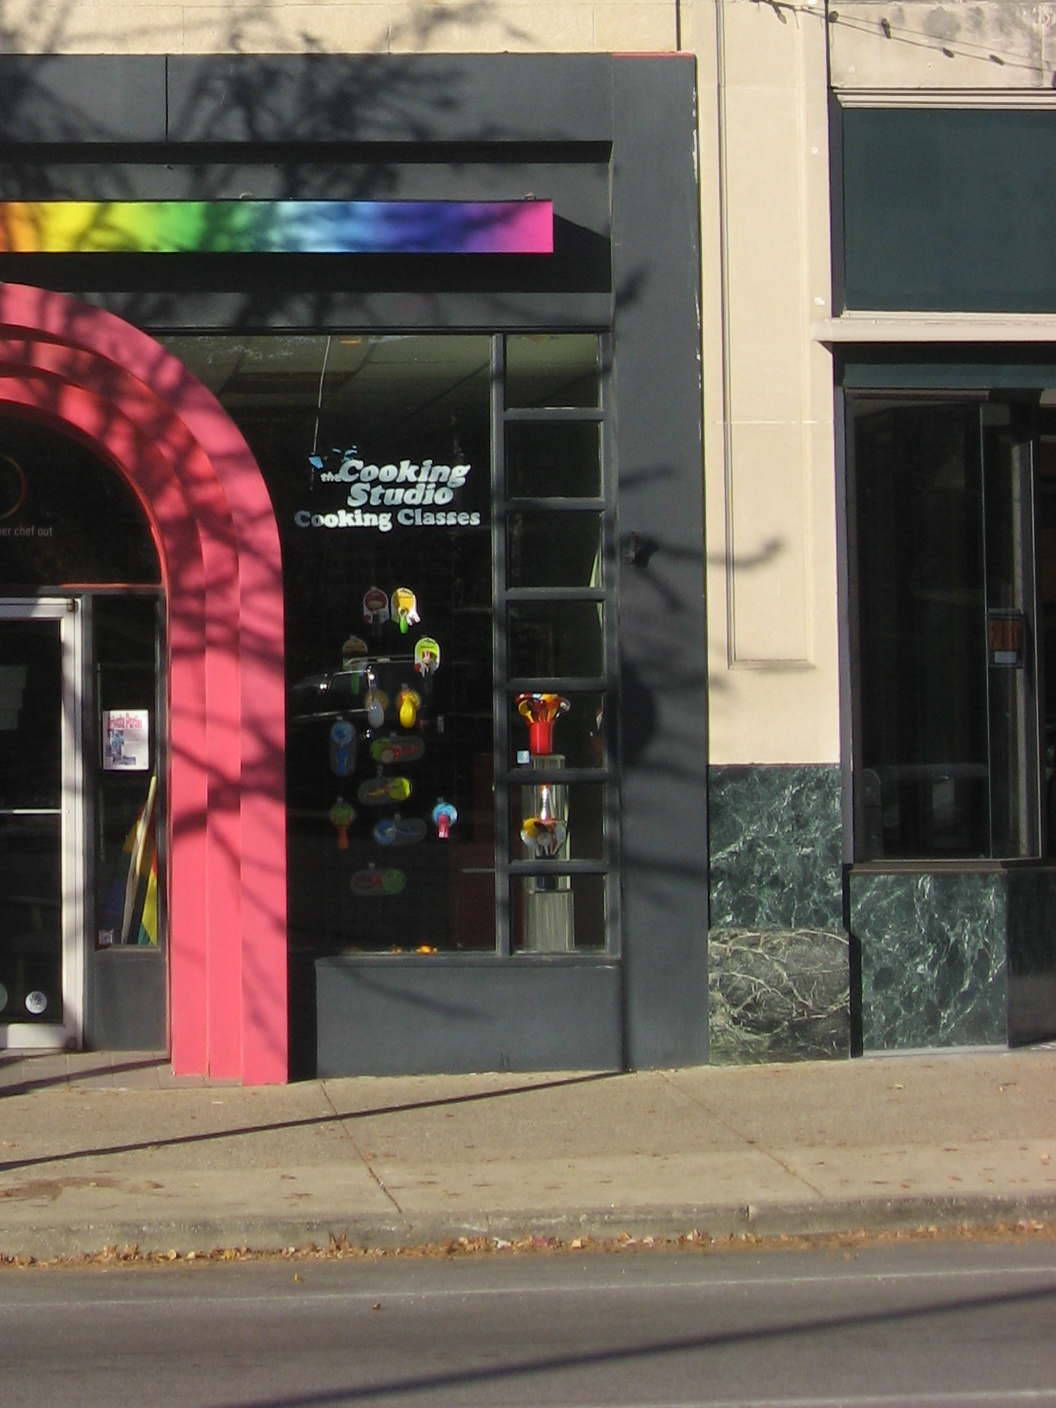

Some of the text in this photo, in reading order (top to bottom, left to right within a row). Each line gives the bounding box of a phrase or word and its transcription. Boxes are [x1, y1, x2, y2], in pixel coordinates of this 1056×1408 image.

[320, 459, 471, 488] the Cooking
[347, 482, 454, 507] Studio
[14, 524, 36, 537] chef
[37, 526, 53, 538] out
[295, 509, 481, 532] Cooking Classes
